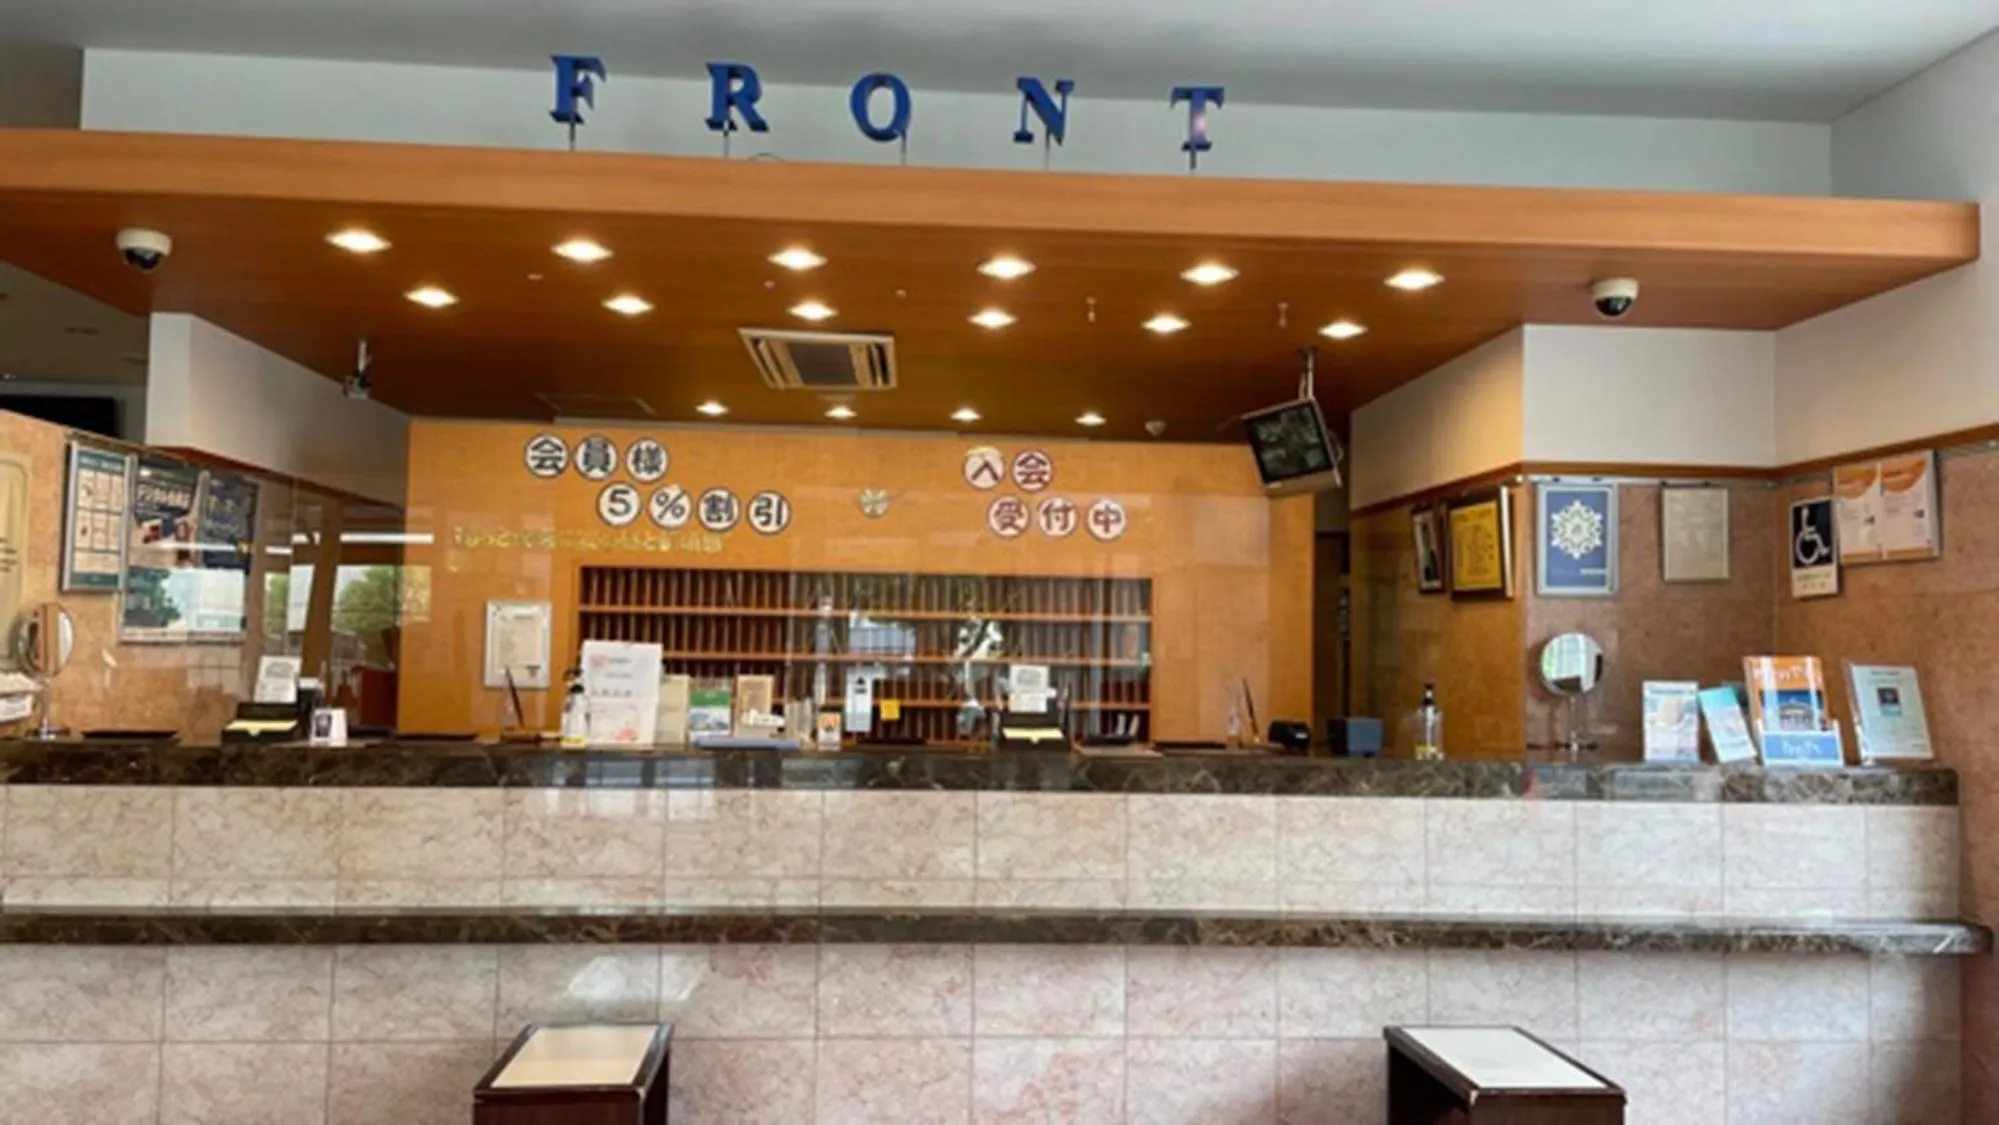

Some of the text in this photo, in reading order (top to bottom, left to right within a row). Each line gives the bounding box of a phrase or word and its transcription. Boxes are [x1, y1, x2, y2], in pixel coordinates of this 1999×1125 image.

[549, 54, 1226, 153] FRONT
[531, 437, 661, 475] 会員様
[994, 500, 1122, 533] 受付中
